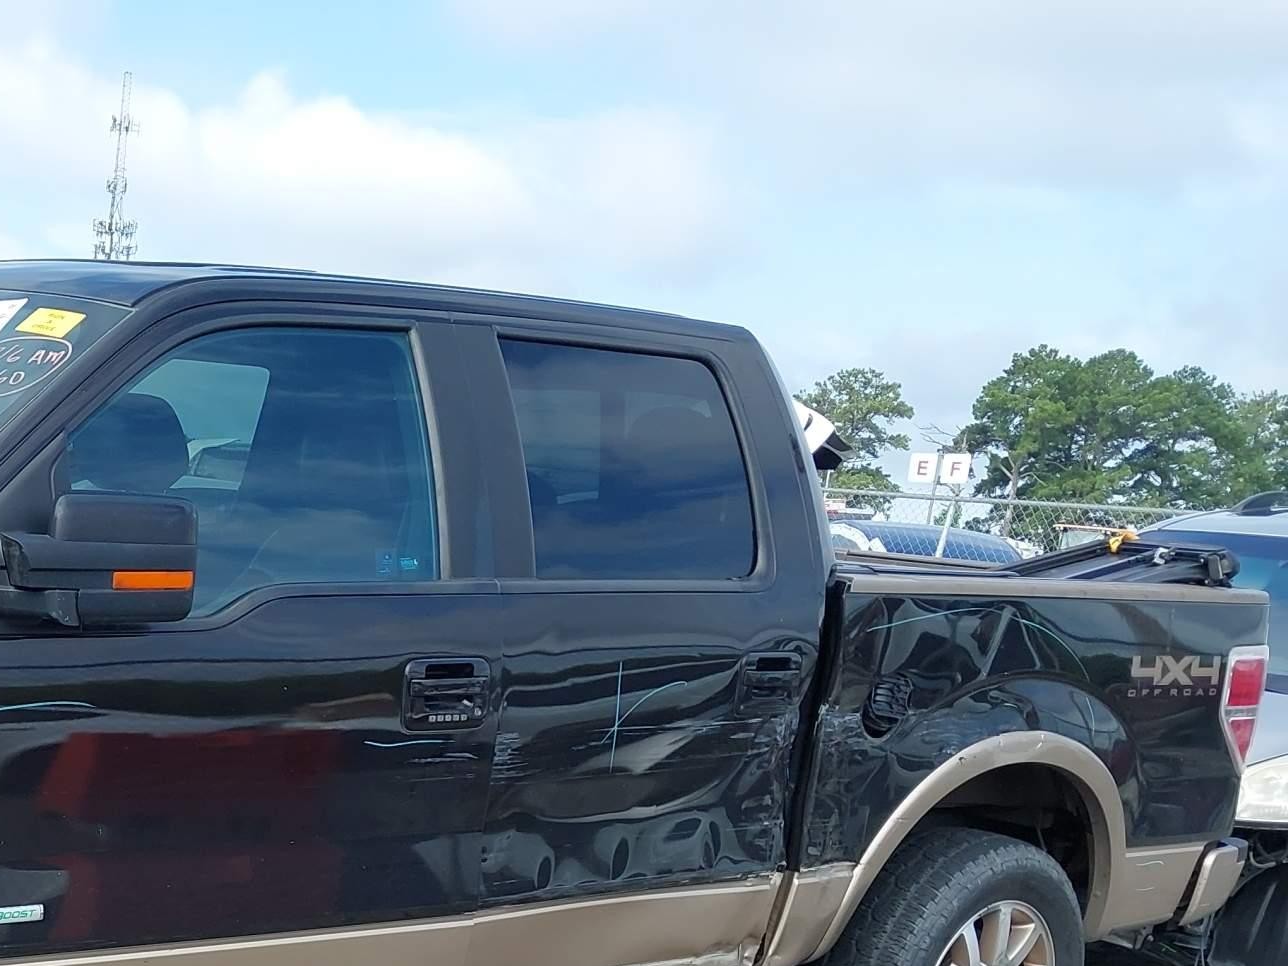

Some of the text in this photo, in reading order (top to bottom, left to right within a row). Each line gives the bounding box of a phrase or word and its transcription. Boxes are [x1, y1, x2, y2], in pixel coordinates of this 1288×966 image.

[27, 349, 66, 365] AM
[917, 460, 929, 475] E
[950, 461, 962, 477] F
[1127, 688, 1217, 698] OFF ROAD
